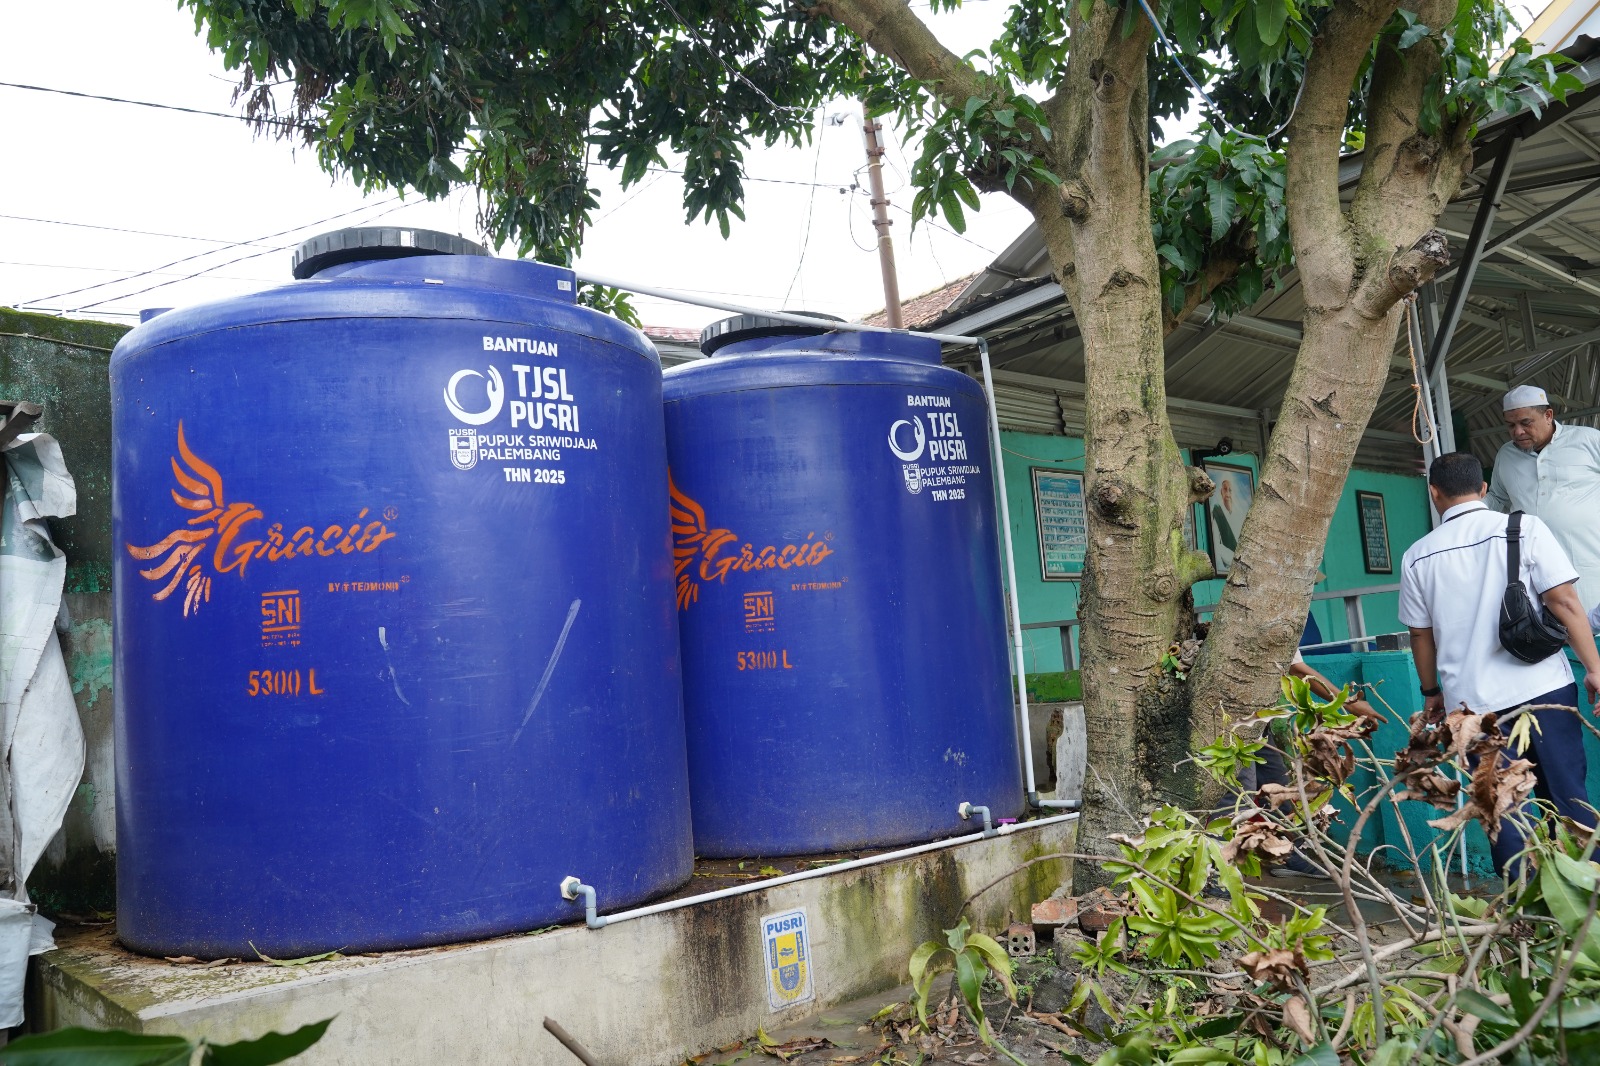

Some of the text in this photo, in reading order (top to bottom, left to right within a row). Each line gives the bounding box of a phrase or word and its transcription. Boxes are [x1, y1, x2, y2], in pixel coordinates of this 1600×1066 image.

[482, 336, 558, 357] BANTUAN
[511, 364, 574, 402] TJSL
[907, 395, 951, 407] BANTUAN
[510, 400, 580, 433] PUSRI
[926, 412, 962, 437] TJSL
[448, 428, 477, 436] PUSRI
[478, 435, 598, 450] PUPUK SRIWIDJAJA
[928, 439, 967, 461] PUSRI
[479, 448, 561, 461] PALEMBANG
[503, 467, 566, 484] THN 2025
[920, 466, 947, 477] PUPUK
[922, 475, 965, 487] PALEMBANG
[931, 488, 965, 502] THN 2025
[261, 597, 300, 625] SNI
[743, 596, 774, 617] SNI
[737, 649, 792, 671] 5300 L
[247, 668, 324, 697] 5300 L
[767, 917, 803, 935] PUSRI
